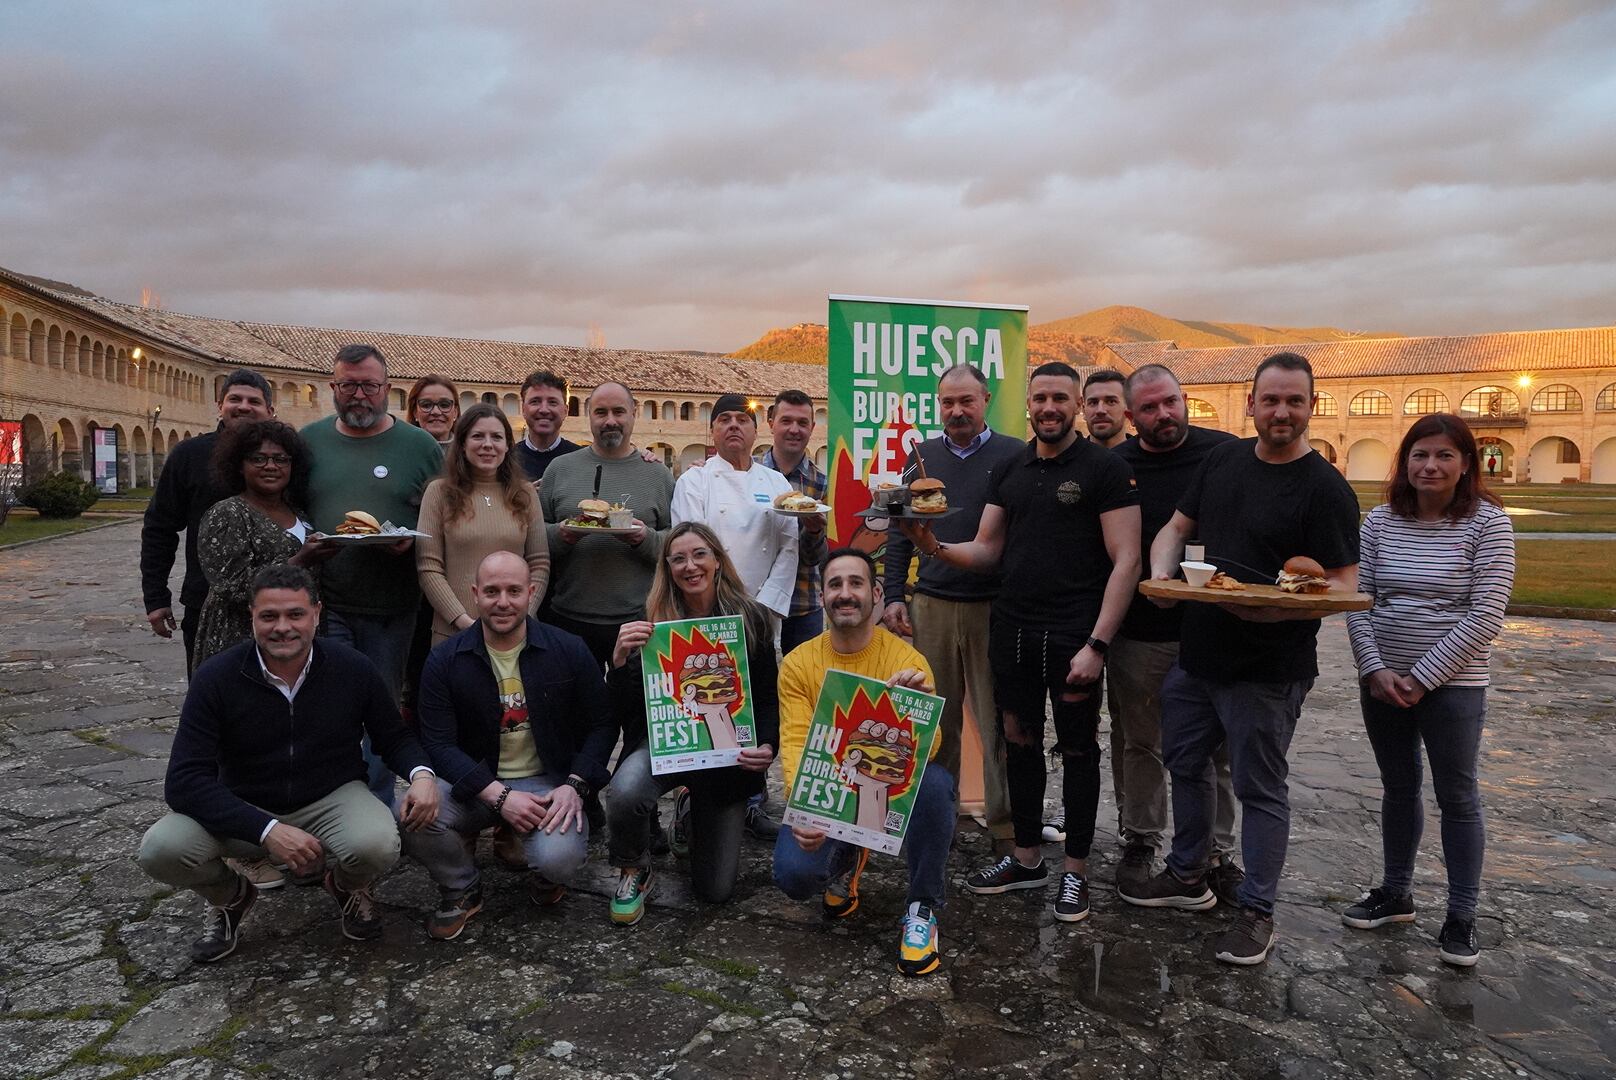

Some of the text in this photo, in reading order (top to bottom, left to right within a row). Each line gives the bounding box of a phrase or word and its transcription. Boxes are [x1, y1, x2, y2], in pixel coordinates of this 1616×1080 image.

[853, 321, 1005, 380] HUESCA
[853, 428, 944, 481] FE
[699, 624, 710, 632] DEL
[720, 622, 727, 631] AL
[728, 621, 737, 630] 26
[709, 630, 738, 640] DE MARZO
[647, 672, 674, 699] HU
[651, 702, 699, 722] BURGER
[891, 691, 935, 711] DEL 16 AL 26
[898, 704, 932, 721] DE MARZO
[652, 720, 699, 748] FEST
[808, 723, 844, 755] HU
[802, 758, 857, 785] BURGER
[794, 775, 852, 812] FEST
